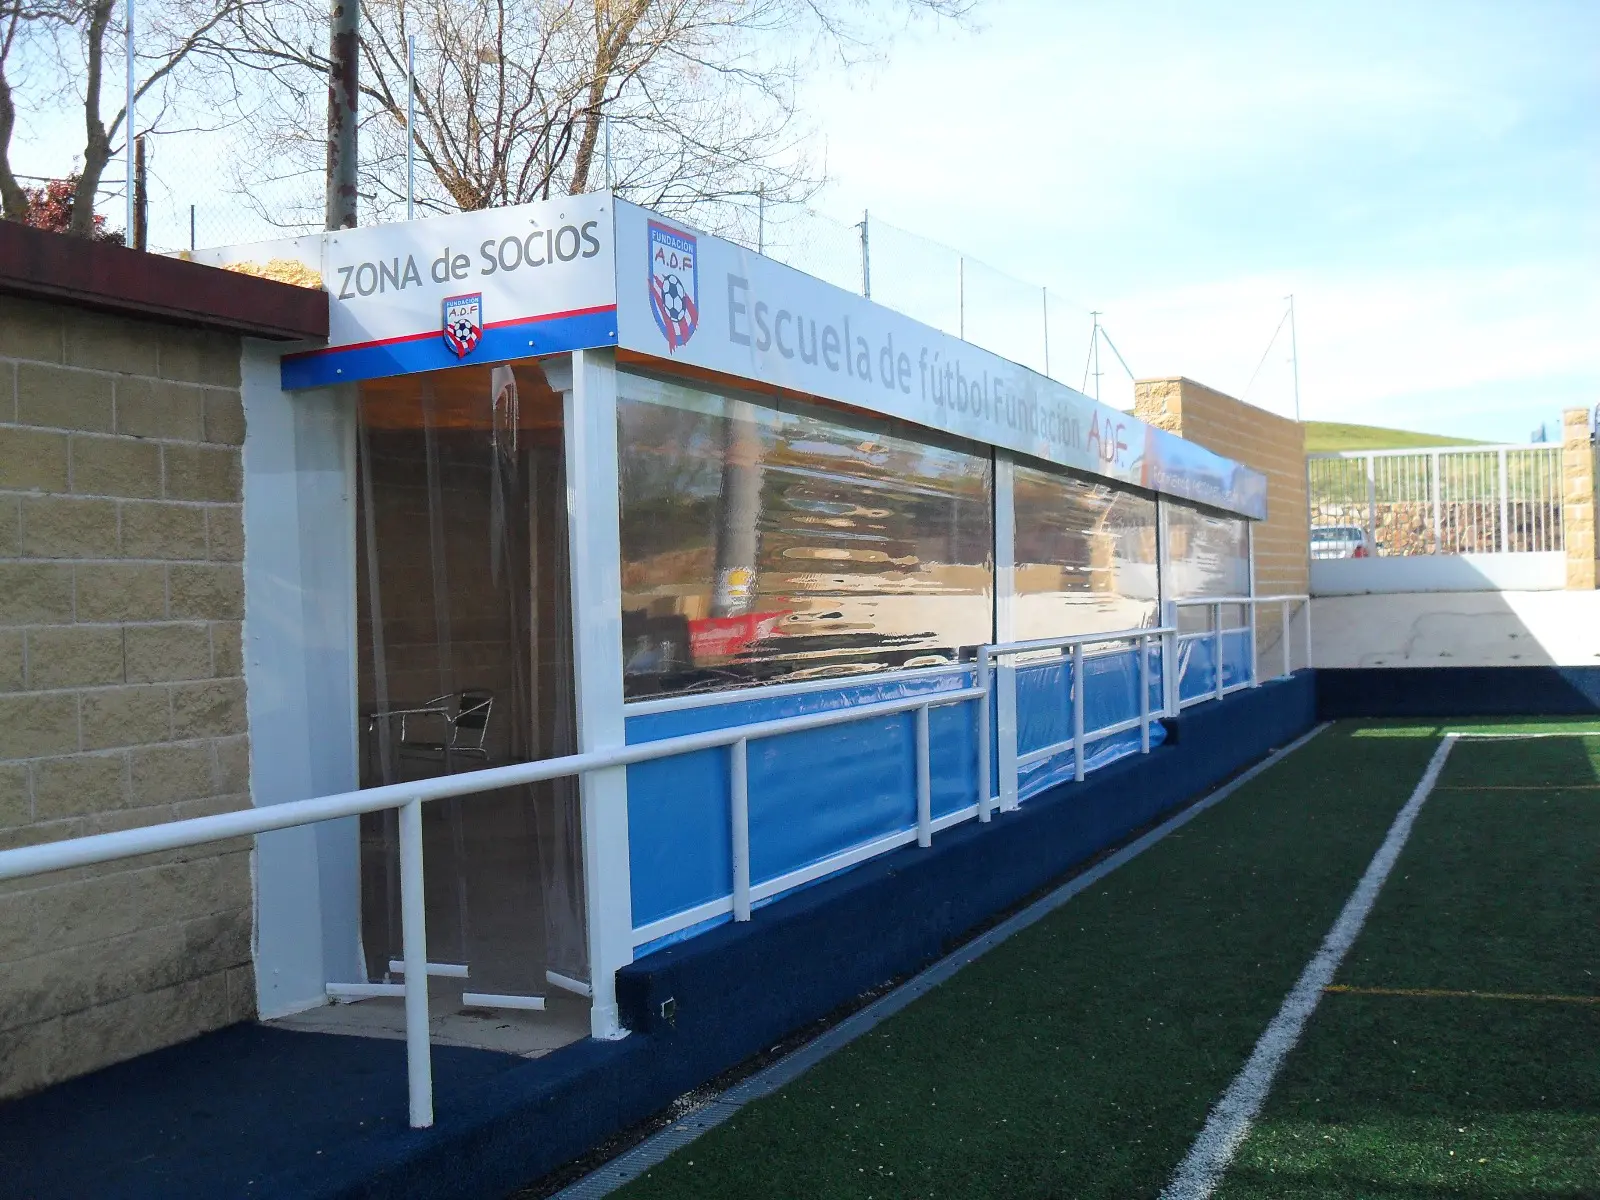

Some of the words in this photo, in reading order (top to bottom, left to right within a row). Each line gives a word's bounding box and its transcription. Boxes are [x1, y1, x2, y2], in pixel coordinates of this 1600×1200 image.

[338, 254, 422, 300] ZONA
[431, 246, 471, 283] de
[481, 220, 601, 276] SOCIOS
[652, 230, 693, 253] FUNDACIÓN
[655, 247, 693, 271] A.D.F
[727, 273, 873, 383] Escuela
[880, 332, 912, 394] de
[919, 346, 989, 420] fútbol
[993, 377, 1080, 449] Fundación
